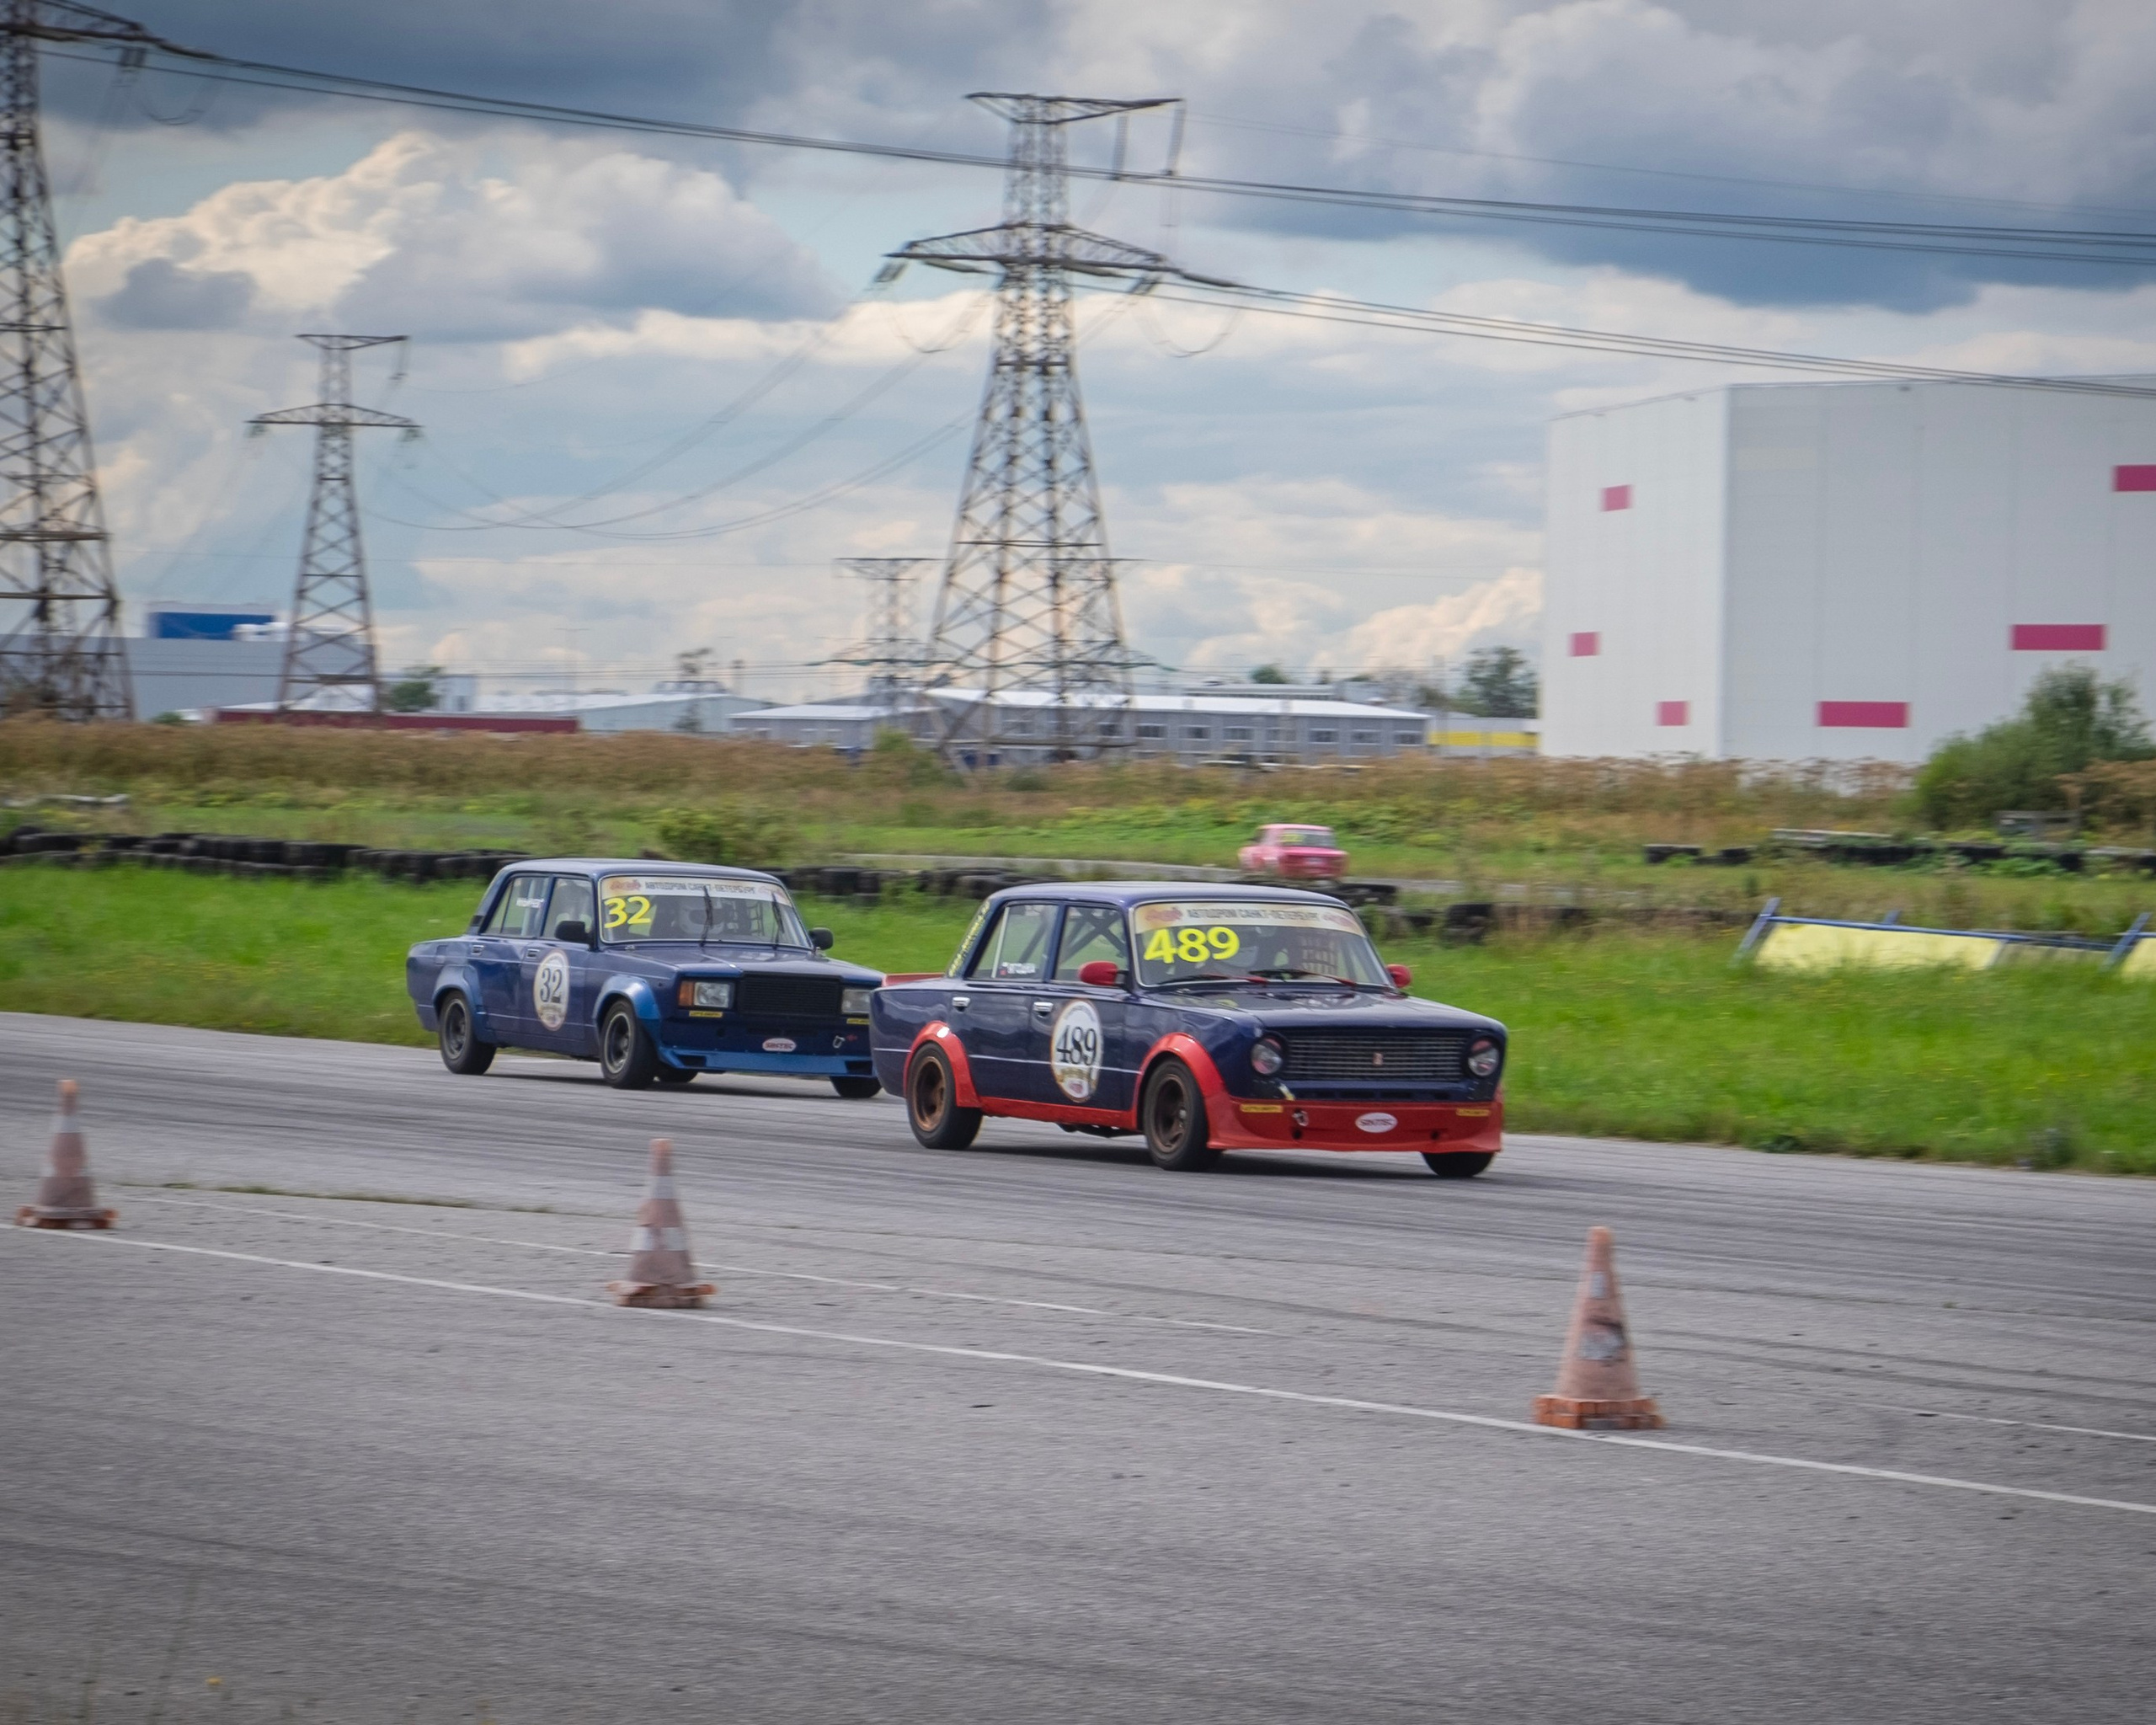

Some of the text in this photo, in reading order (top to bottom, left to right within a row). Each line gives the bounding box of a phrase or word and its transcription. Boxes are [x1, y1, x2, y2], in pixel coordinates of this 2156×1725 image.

[604, 895, 652, 929] 32
[1144, 927, 1241, 964] 489
[540, 968, 563, 1004] 32
[1056, 1024, 1097, 1066] 489
